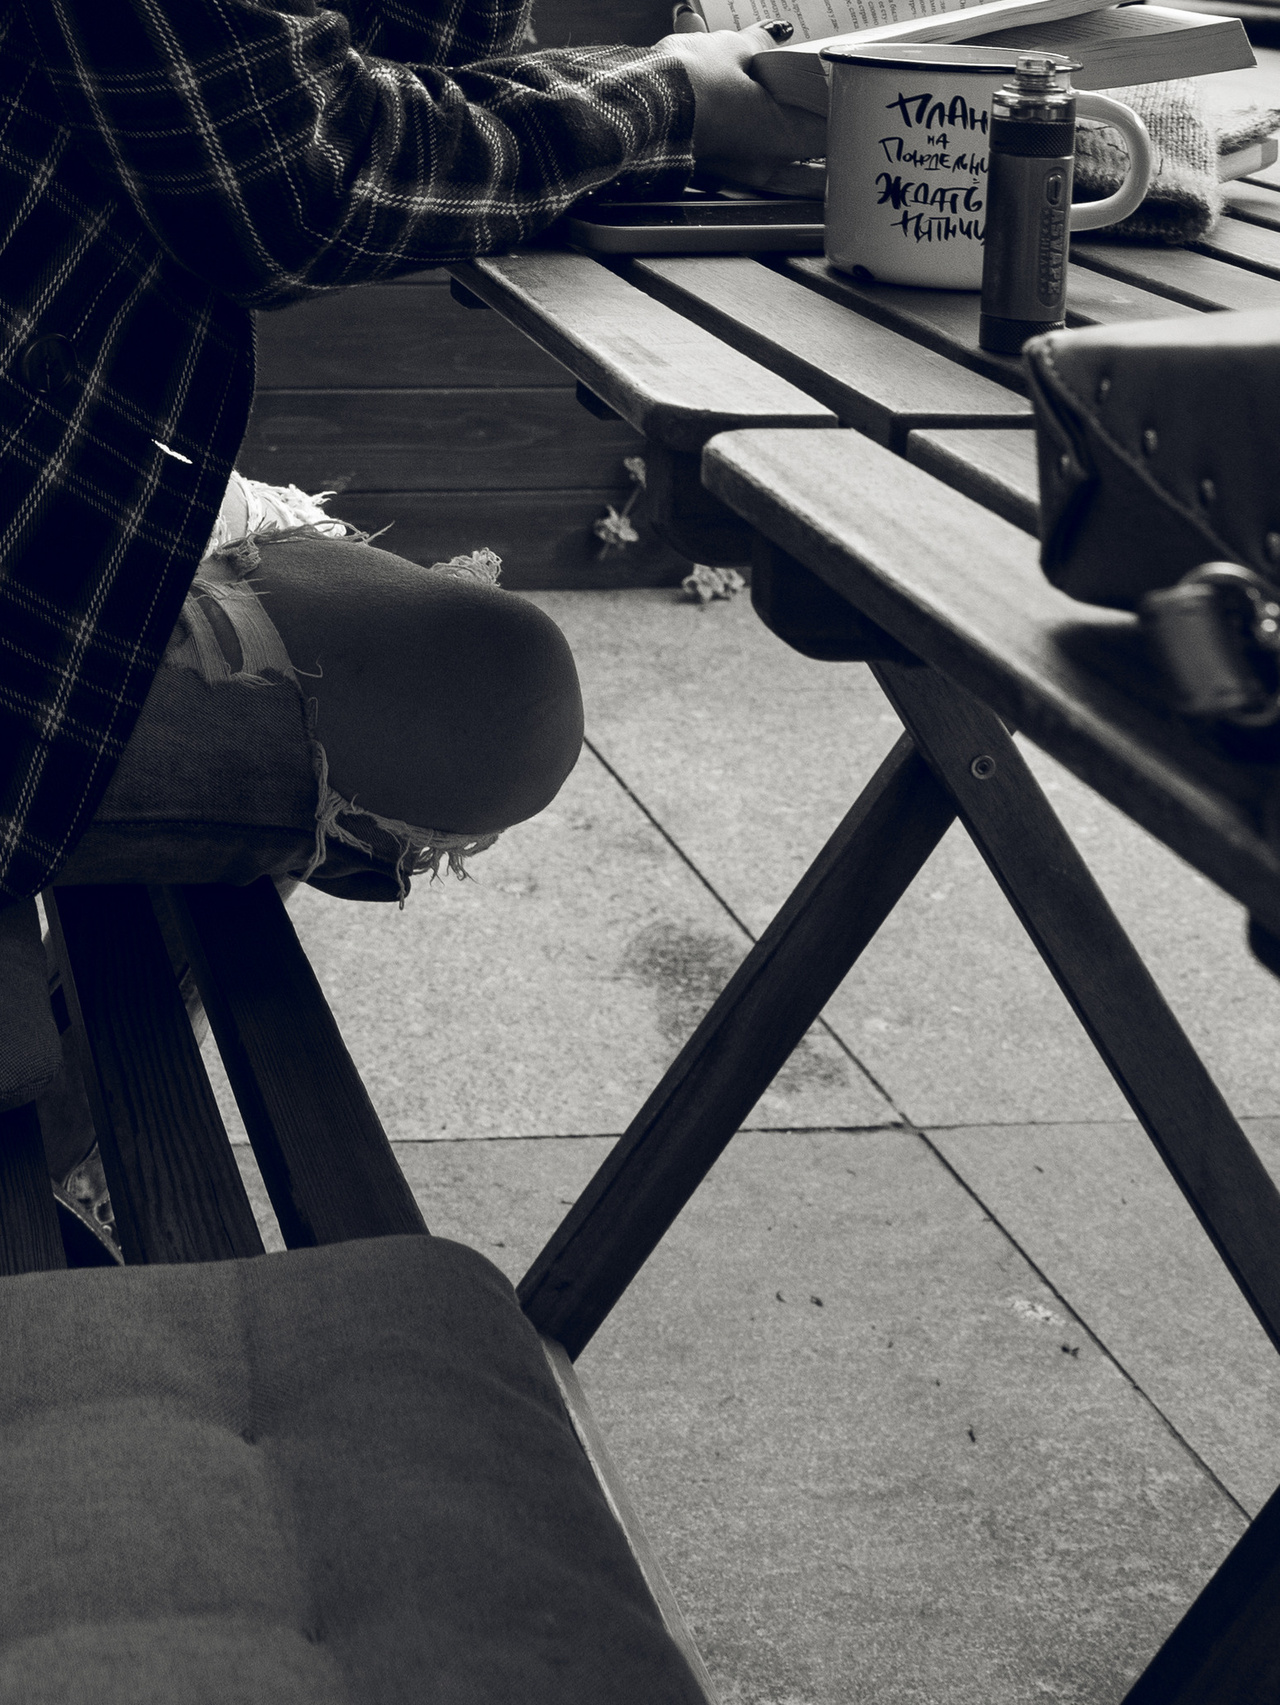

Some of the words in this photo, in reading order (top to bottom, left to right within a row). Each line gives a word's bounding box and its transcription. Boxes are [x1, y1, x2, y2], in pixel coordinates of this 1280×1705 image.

[927, 132, 950, 150] НА
[890, 210, 986, 247] ПЯТНИЦ
[1048, 208, 1065, 294] ASVAPE
